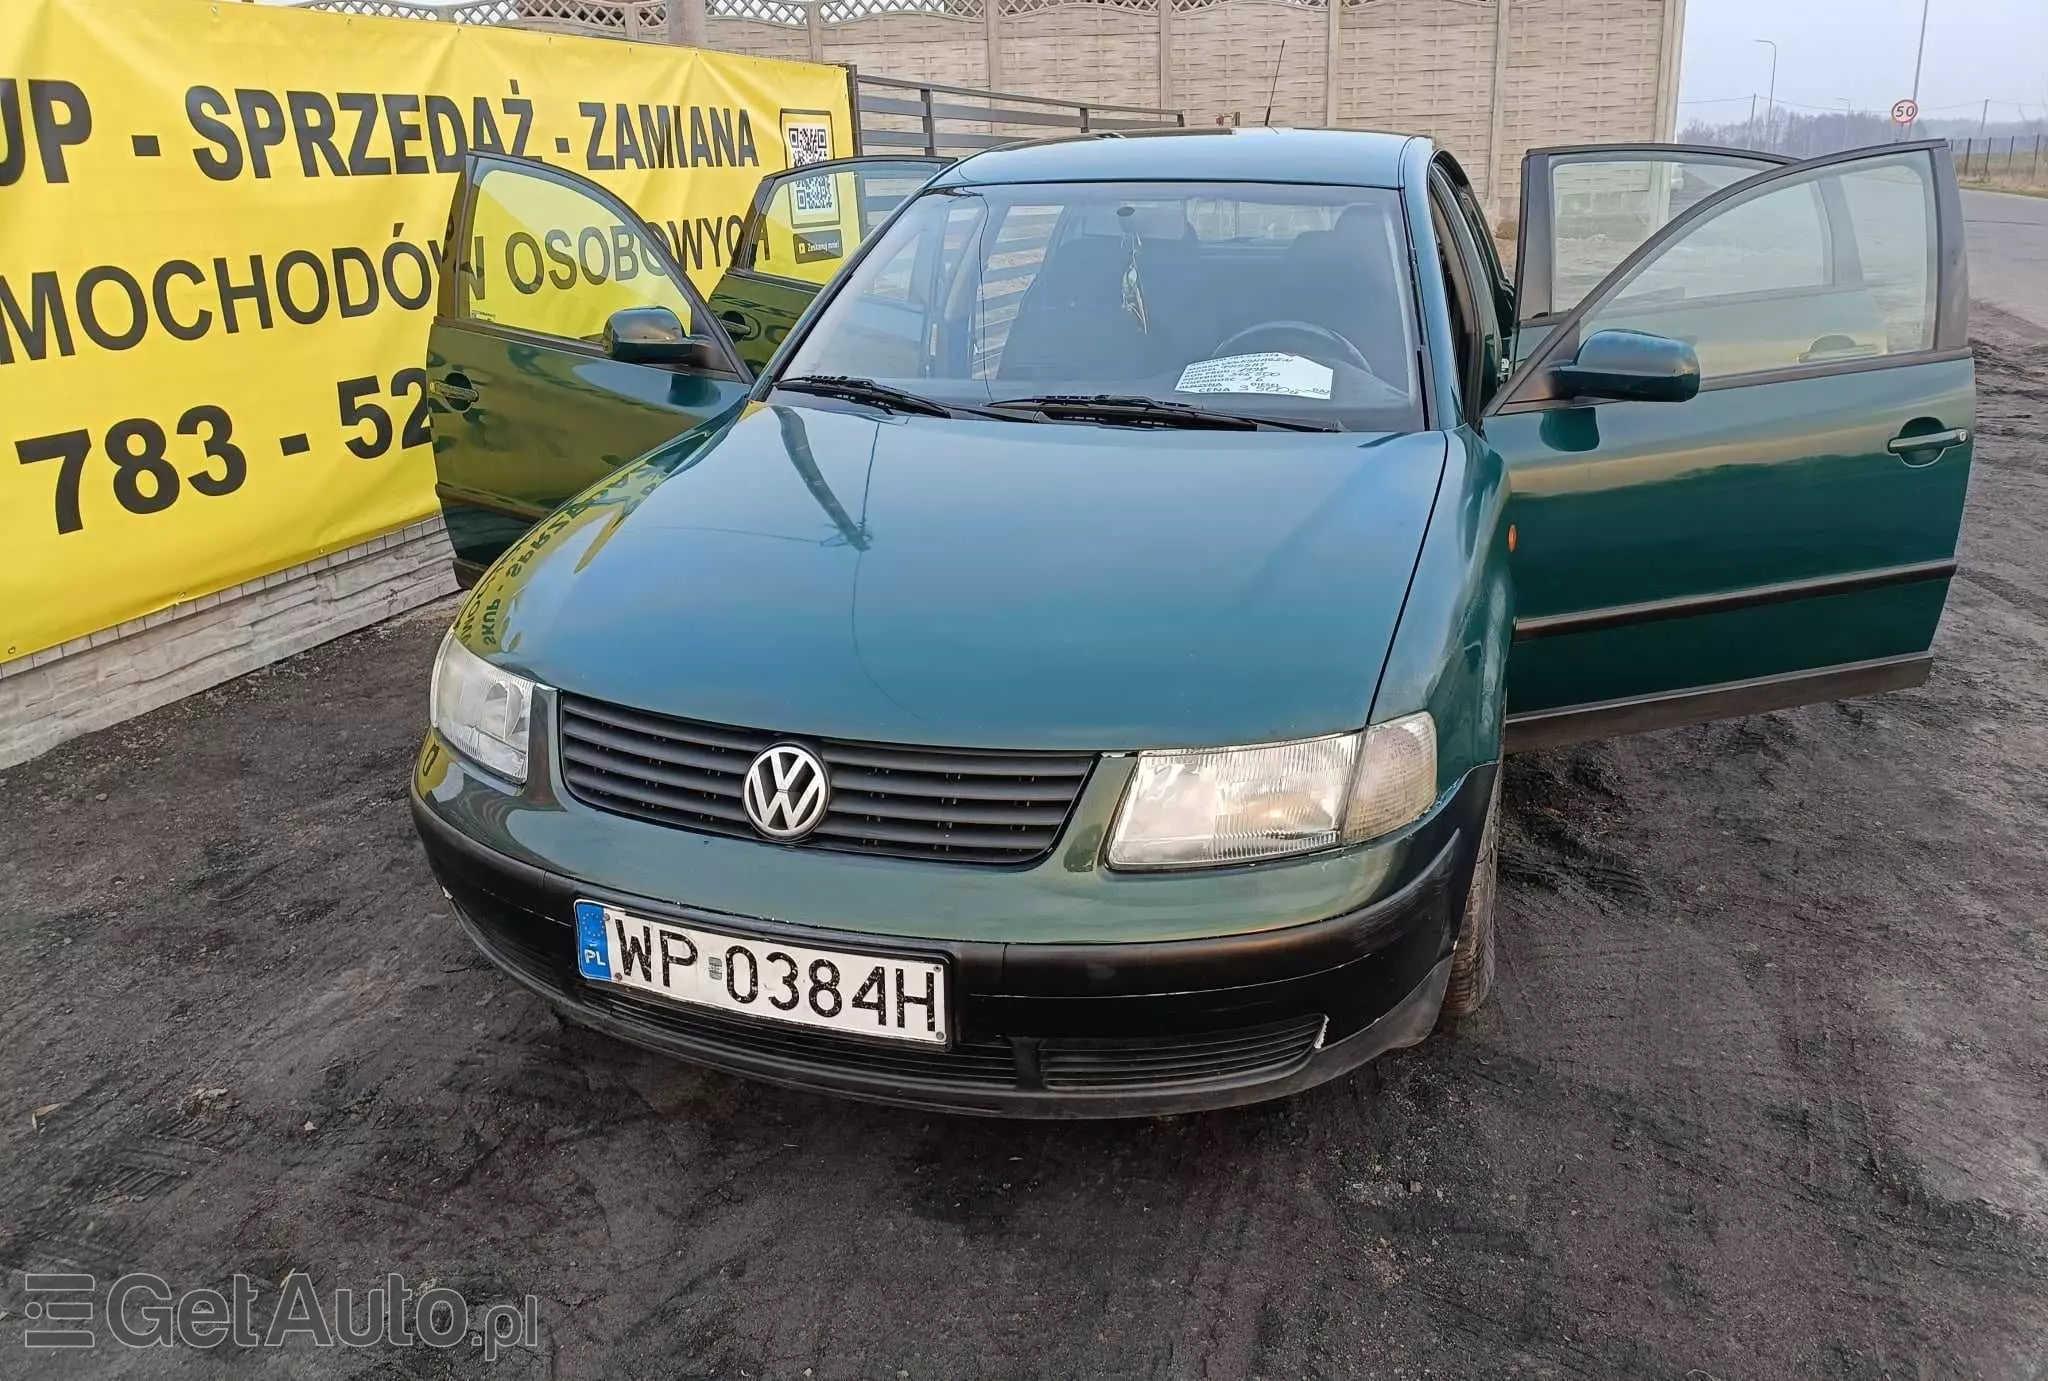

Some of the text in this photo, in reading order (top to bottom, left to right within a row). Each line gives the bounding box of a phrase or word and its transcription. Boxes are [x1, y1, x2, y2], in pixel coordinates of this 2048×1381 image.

[185, 79, 542, 181] SPRZEDAŻ
[579, 101, 759, 170] ZAMIANA
[1896, 105, 1915, 117] 50
[14, 405, 247, 535] 783
[584, 949, 606, 967] PL
[614, 919, 936, 1032] WP 0384H
